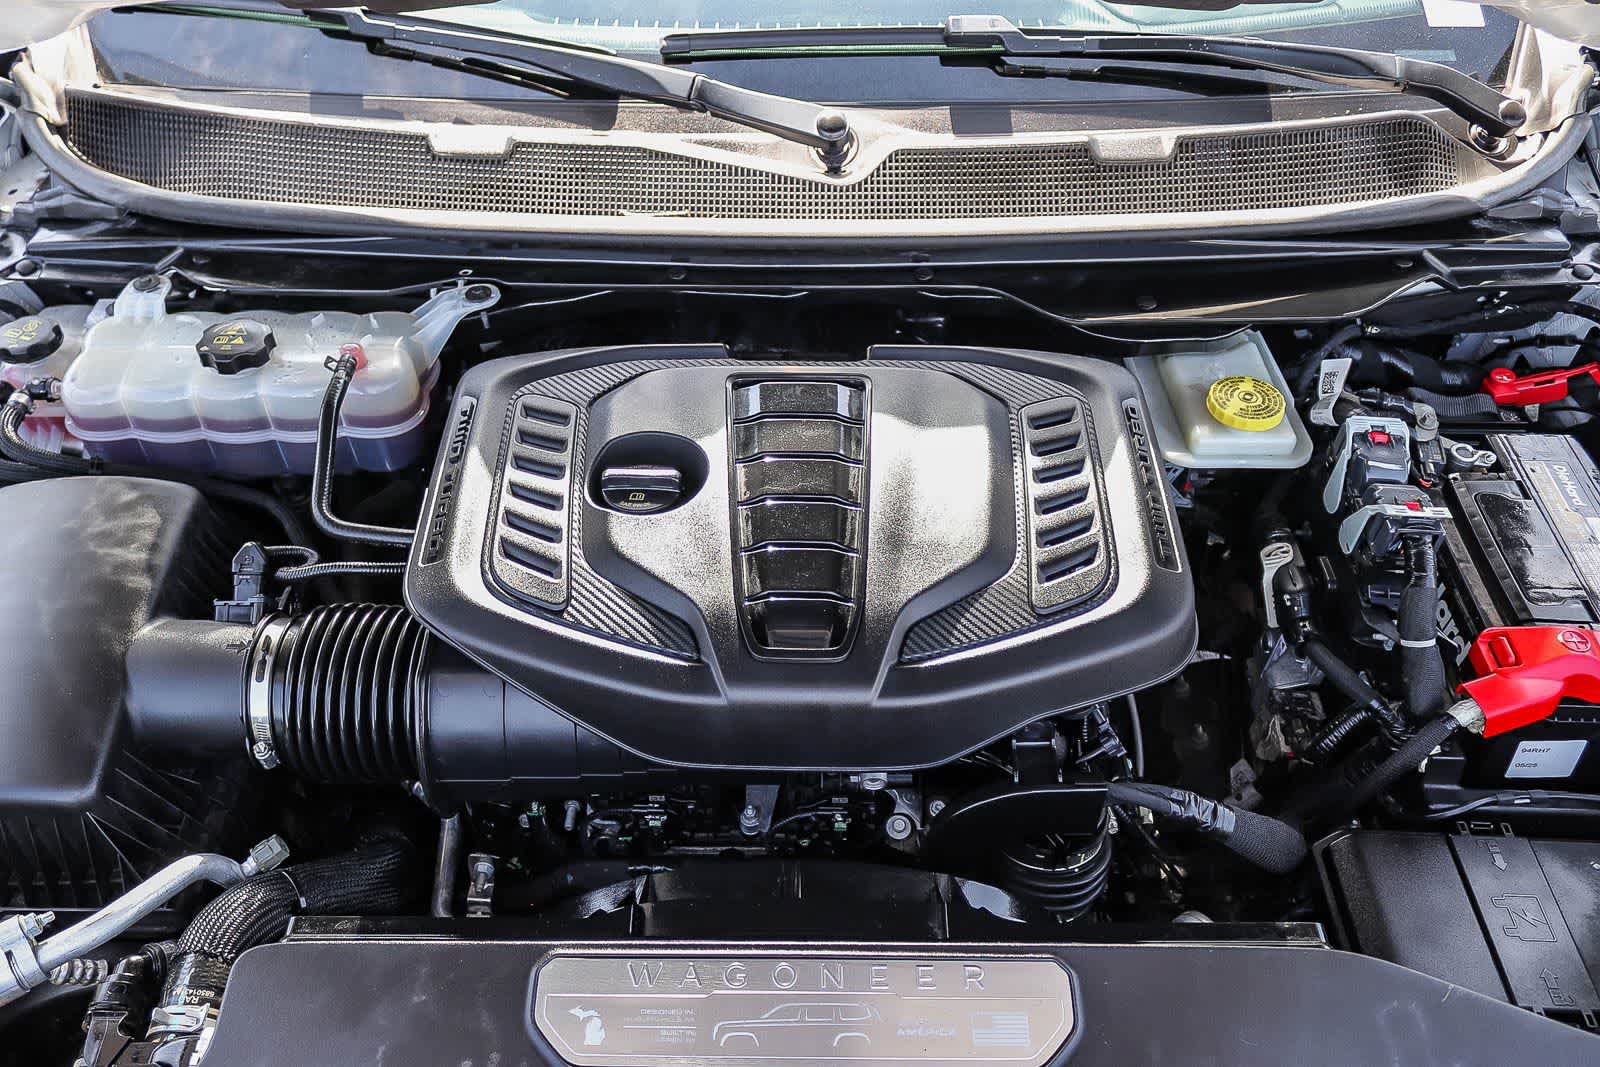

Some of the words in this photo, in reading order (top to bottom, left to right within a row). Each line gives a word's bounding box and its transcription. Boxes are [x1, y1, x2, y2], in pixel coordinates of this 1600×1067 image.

[1125, 404, 1154, 488] TURBO
[1553, 464, 1588, 508] DieHard
[627, 961, 985, 990] WAGONEER
